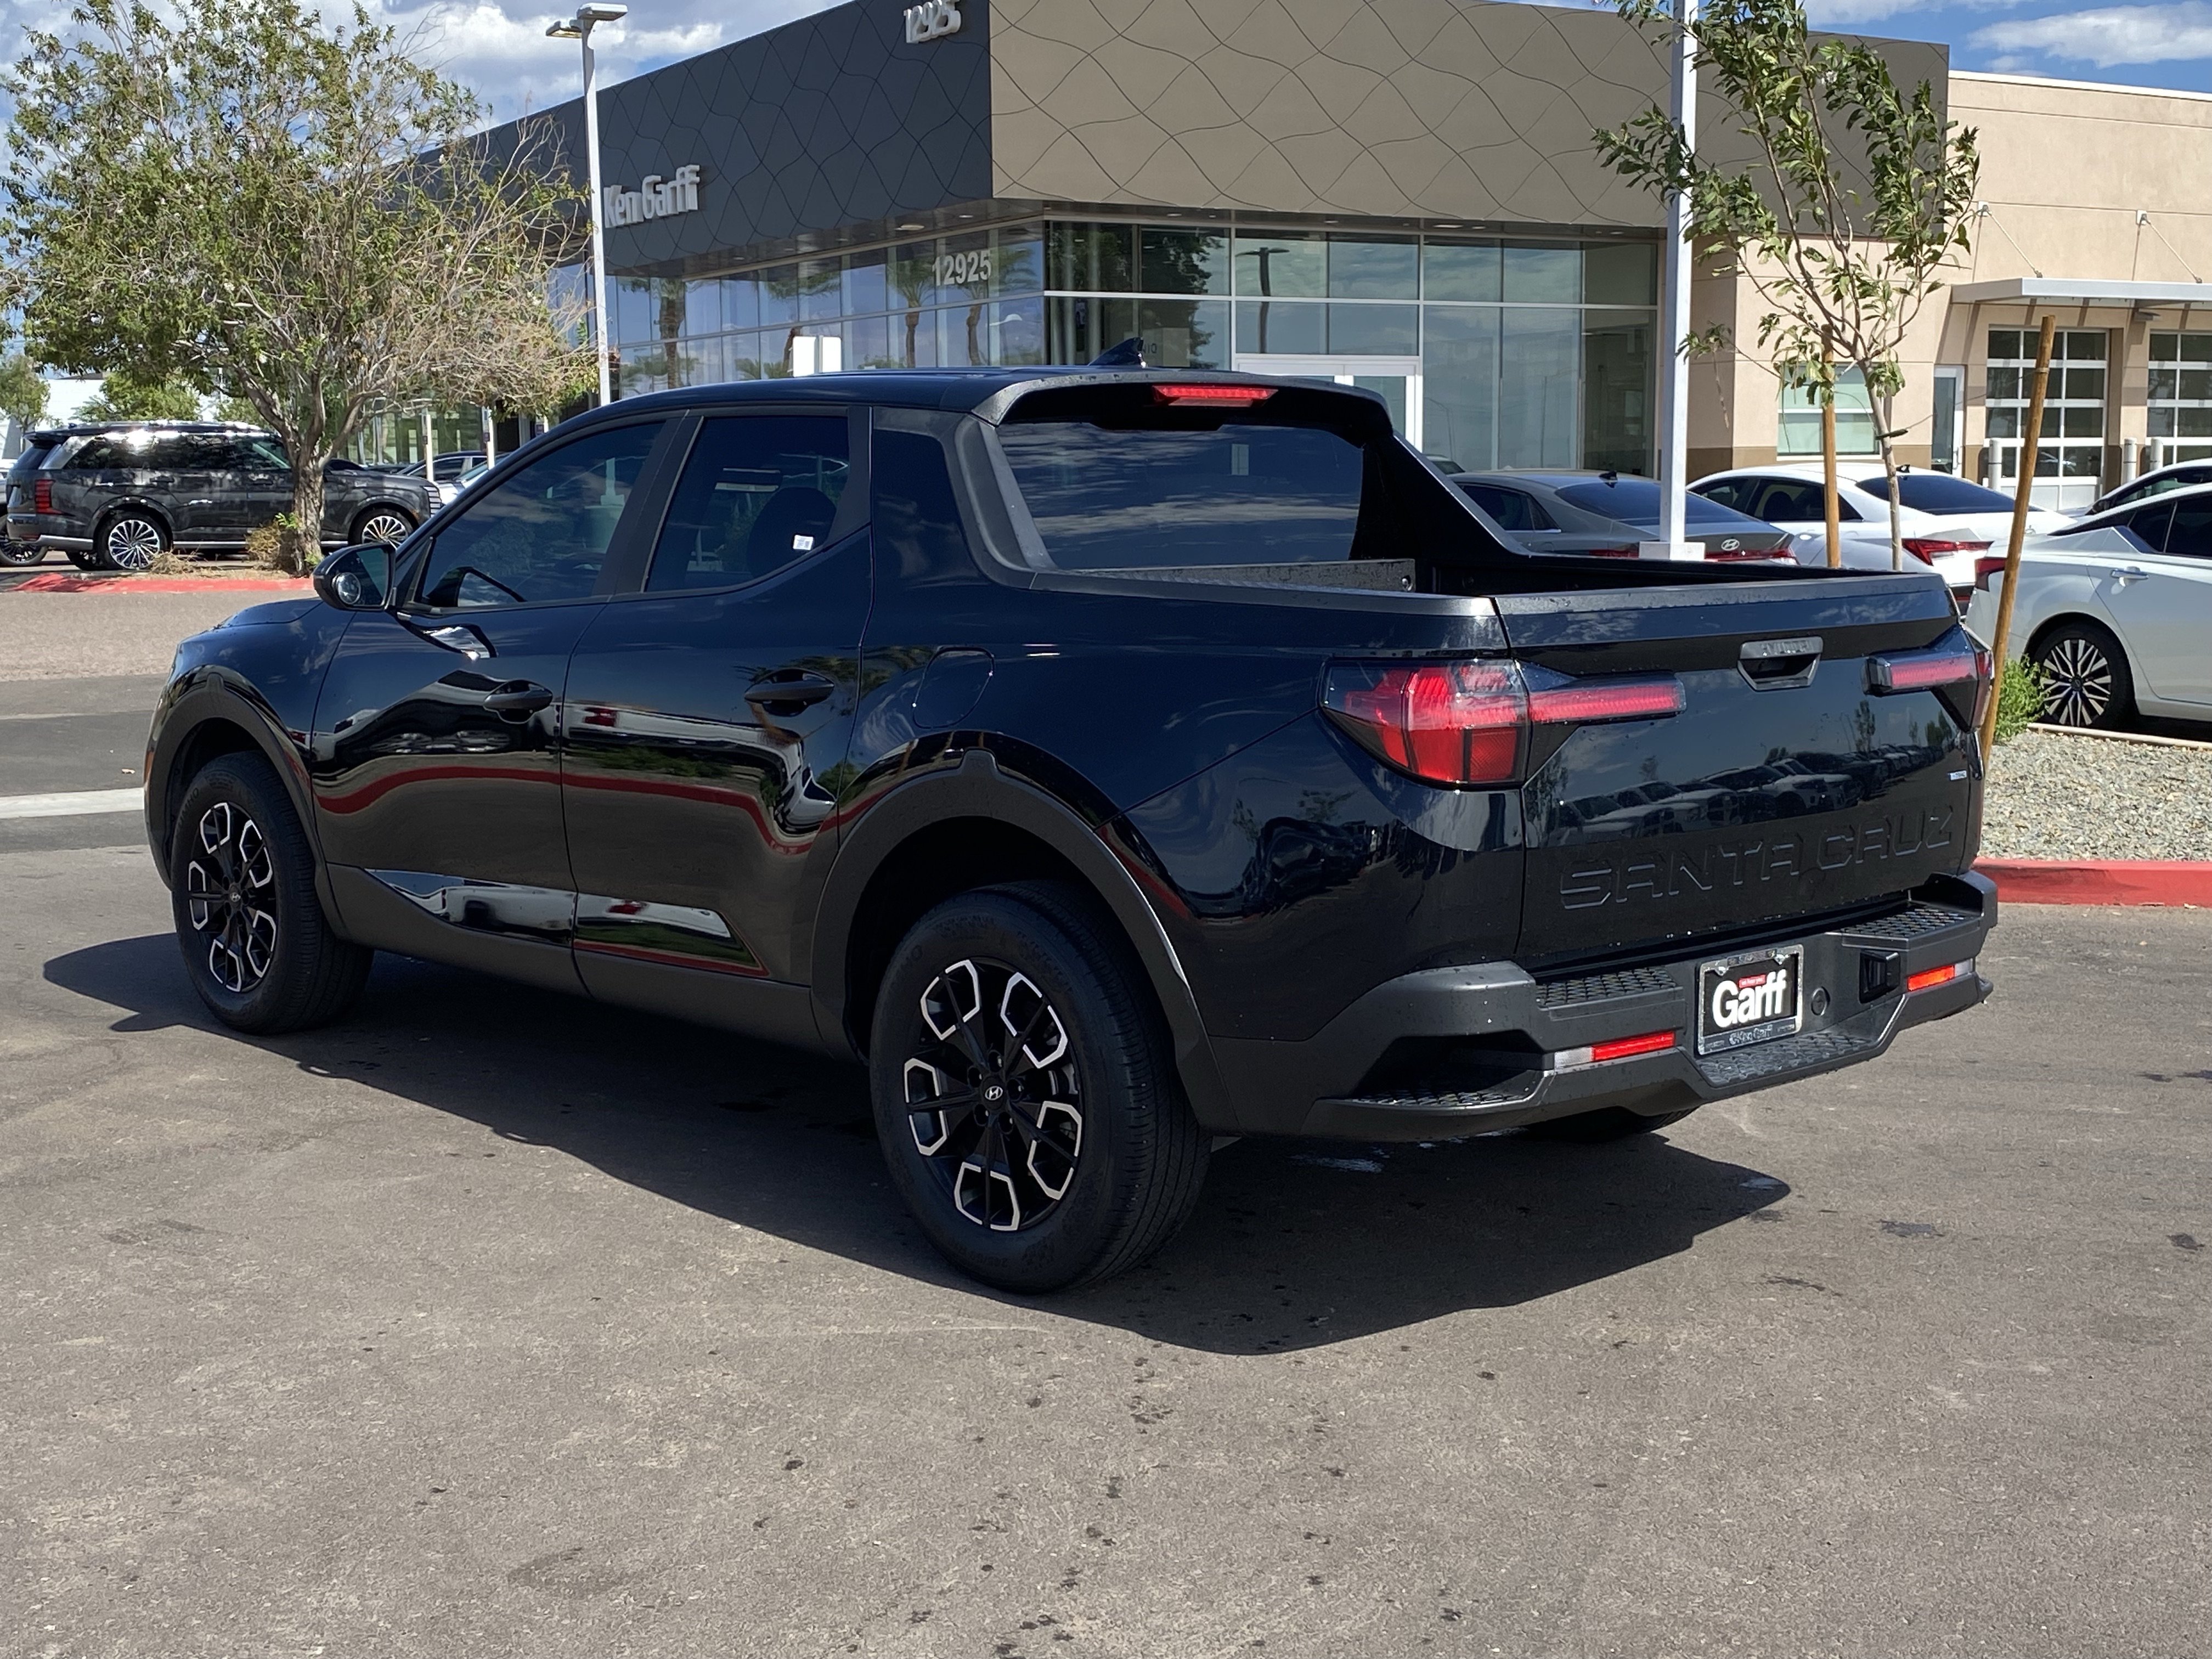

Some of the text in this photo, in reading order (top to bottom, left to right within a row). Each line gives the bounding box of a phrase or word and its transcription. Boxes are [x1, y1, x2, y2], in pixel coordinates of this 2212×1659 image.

[904, 0, 961, 43] 12925
[932, 250, 991, 286] 12925
[1560, 804, 1953, 910] SANTA CRUZ
[1712, 969, 1787, 1028] Garff
